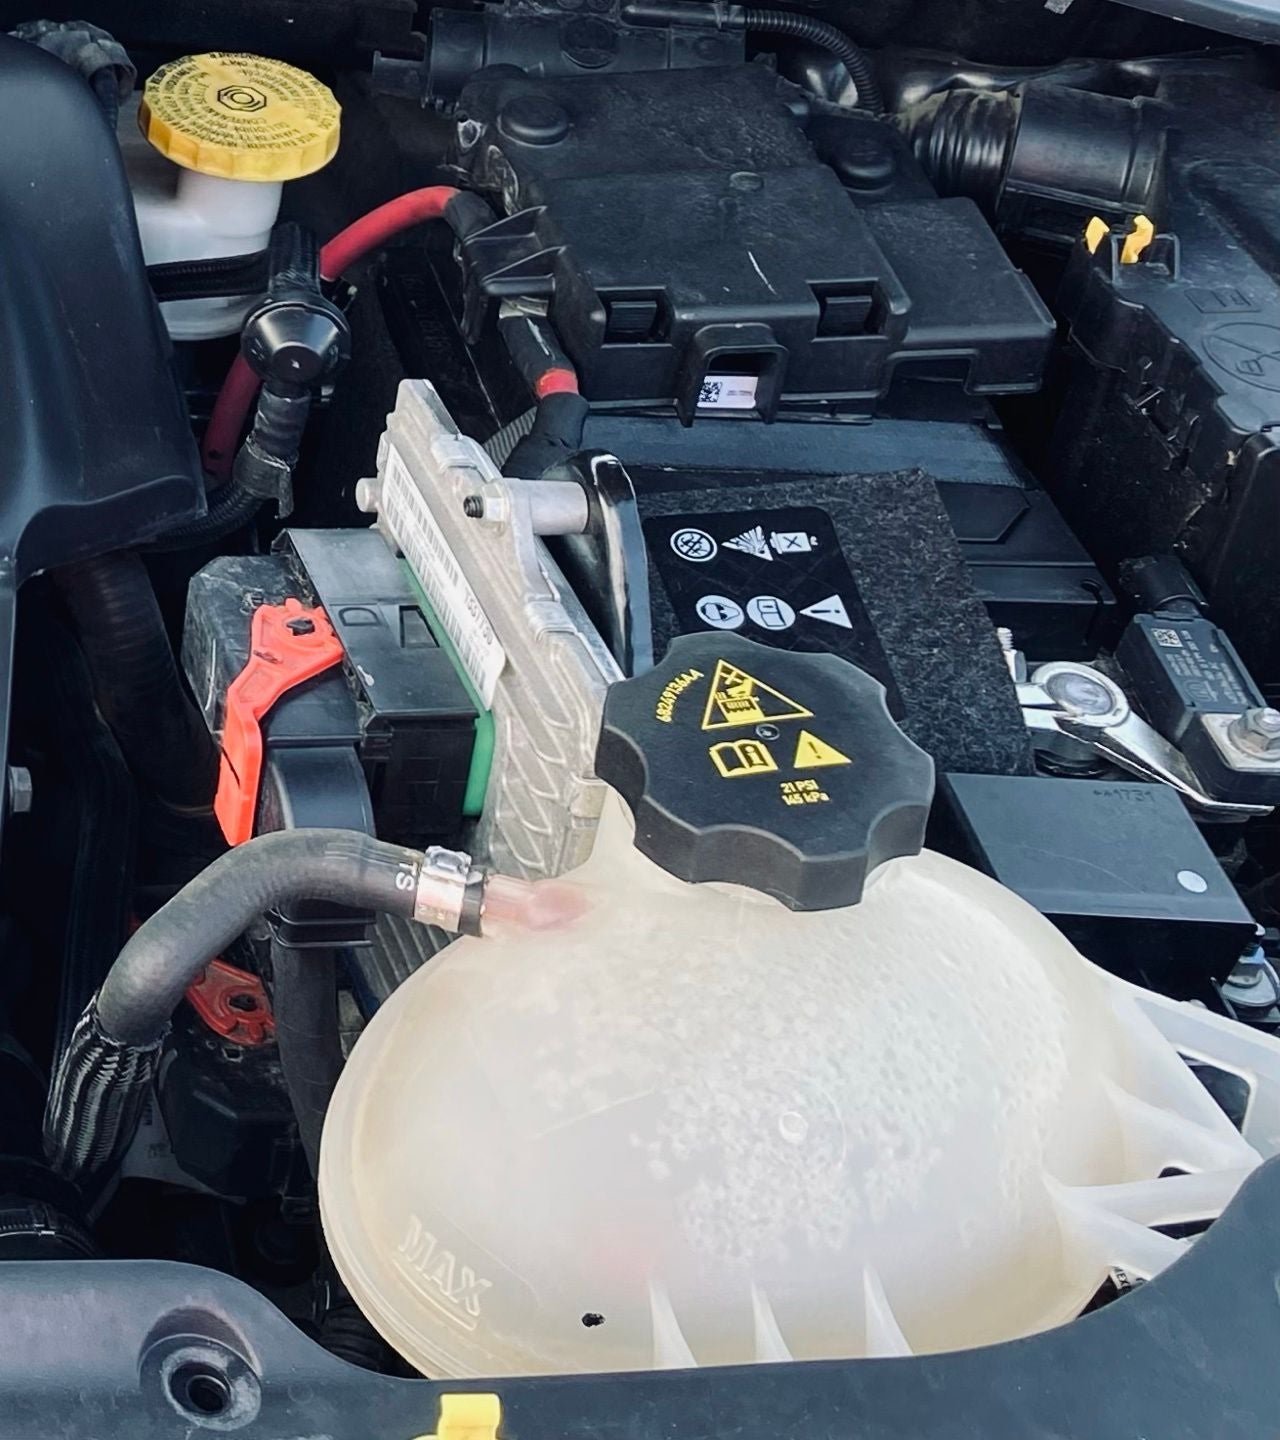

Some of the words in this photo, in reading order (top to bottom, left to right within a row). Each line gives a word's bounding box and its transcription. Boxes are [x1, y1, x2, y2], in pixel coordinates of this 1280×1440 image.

[780, 782, 796, 794] 21
[796, 779, 819, 793] PSI
[781, 793, 804, 806] 145
[805, 789, 830, 804] kPa
[397, 1215, 494, 1317] MAX
